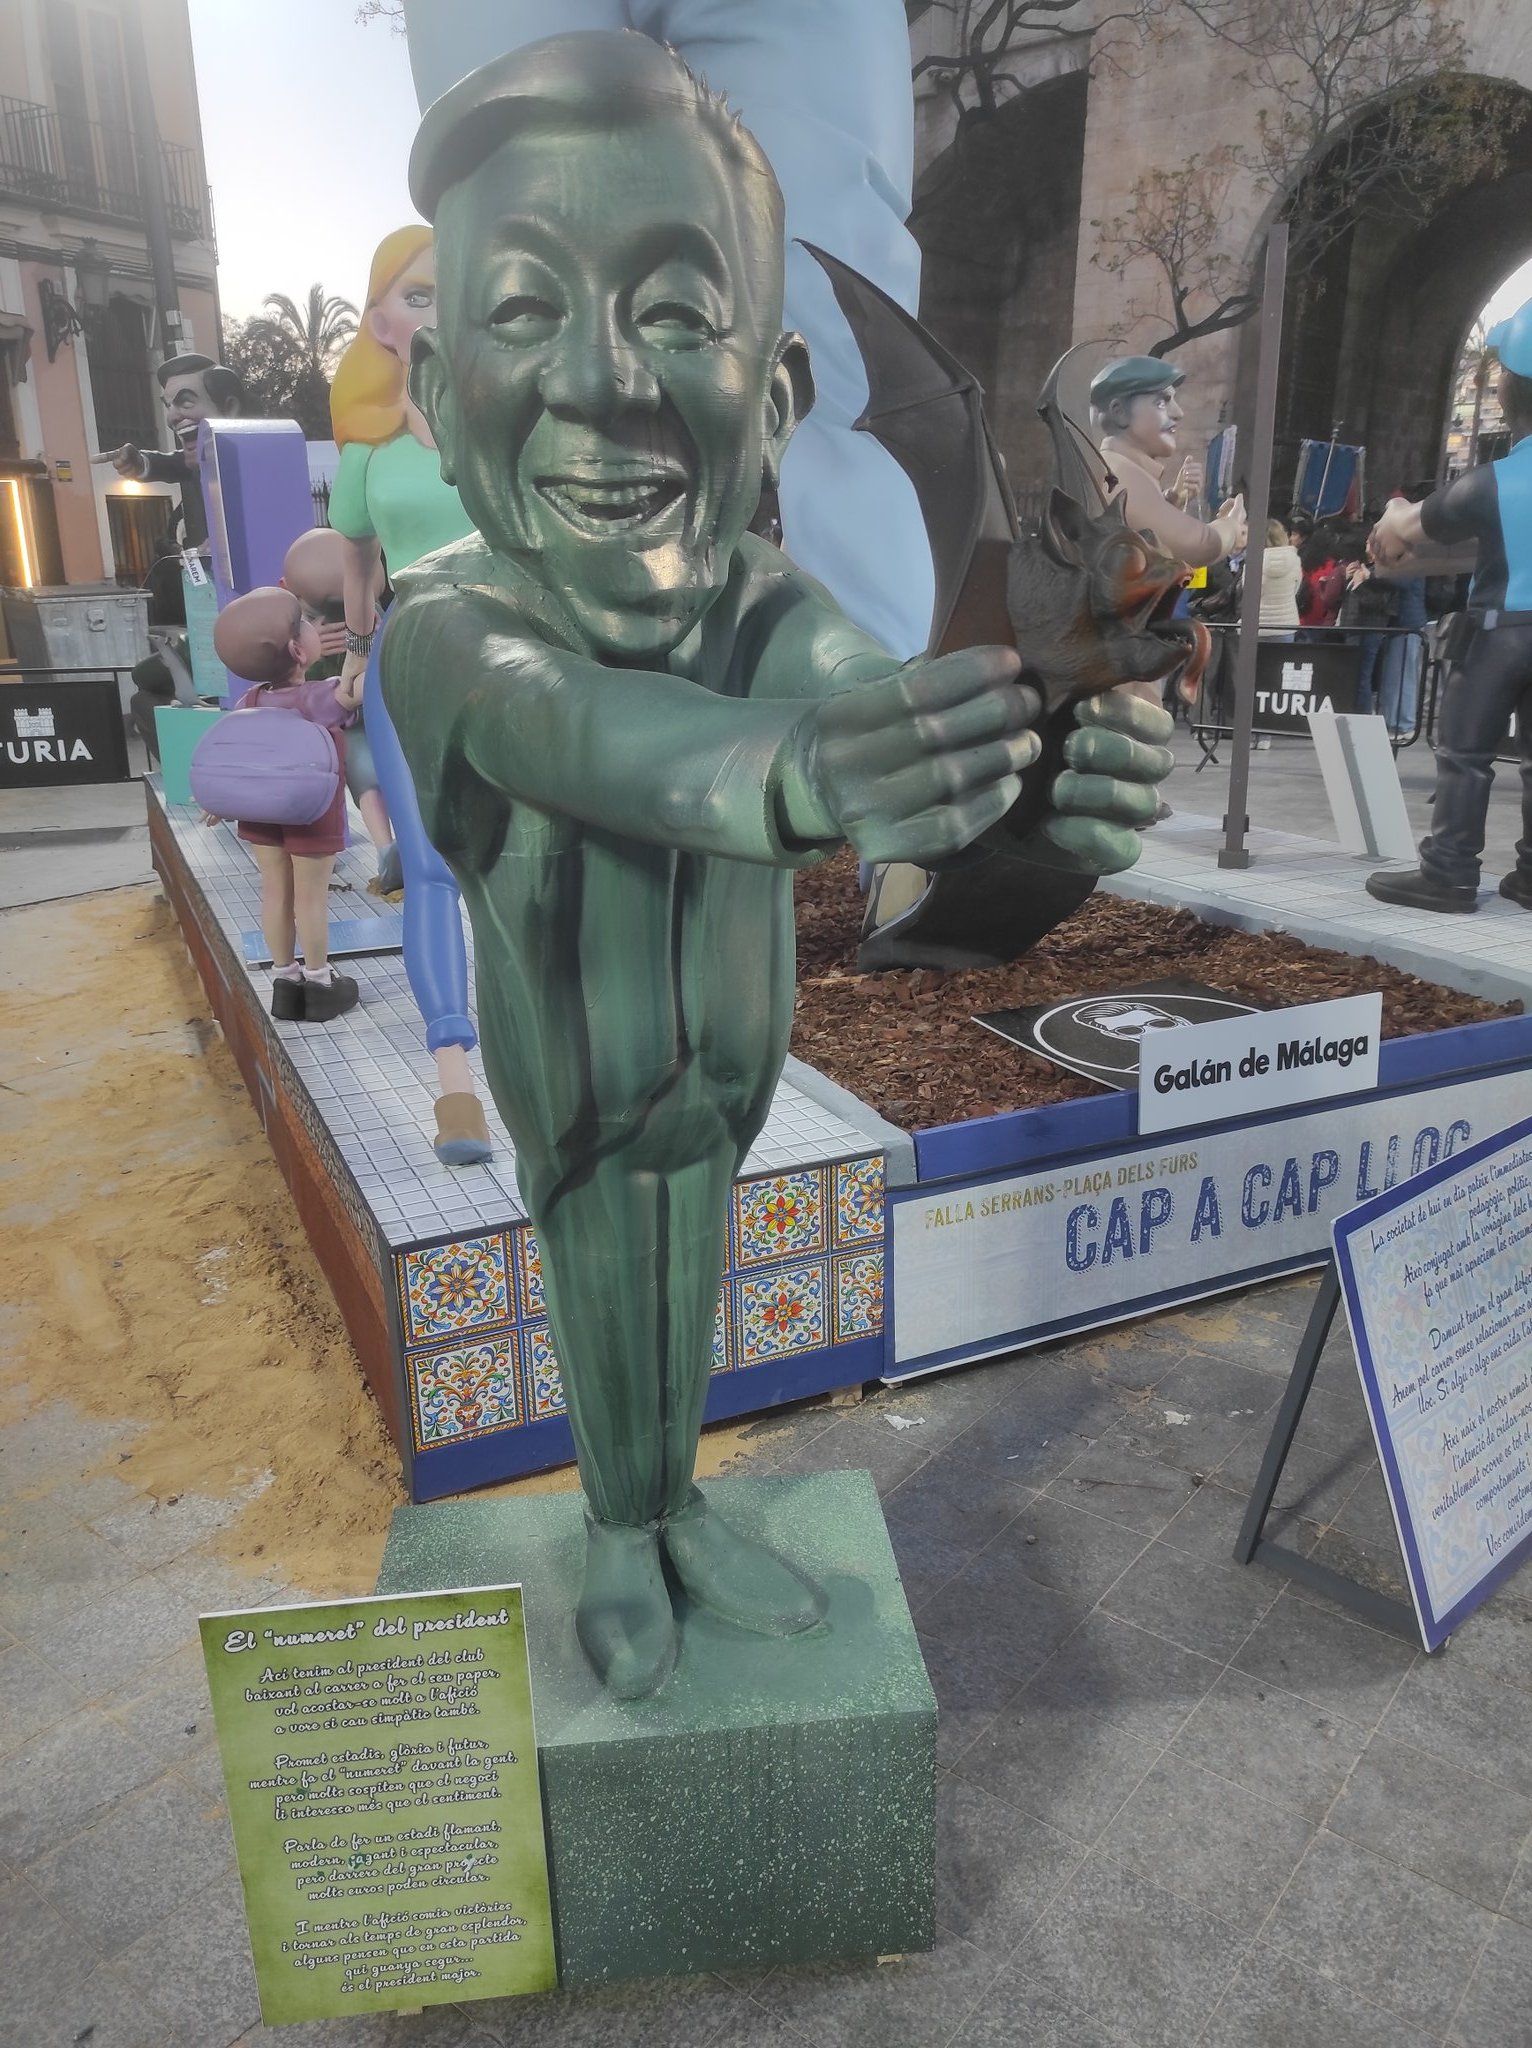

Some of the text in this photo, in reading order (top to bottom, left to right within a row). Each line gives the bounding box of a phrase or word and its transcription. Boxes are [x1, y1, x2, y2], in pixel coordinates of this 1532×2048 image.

[1256, 691, 1334, 716] TURIA
[0, 738, 94, 764] URIA
[1154, 1035, 1368, 1094] Galán de Málaga
[925, 1201, 975, 1230] FALLA
[1117, 1160, 1155, 1185] DELS
[1159, 1151, 1198, 1176] FURS
[1065, 1187, 1175, 1273] CAP
[1190, 1176, 1223, 1242] A
[1241, 1149, 1340, 1230] CAP
[1370, 1171, 1489, 1254] La societat de hui en dia pateix
[1423, 1241, 1455, 1276] conjugat
[1456, 1228, 1471, 1253] amb
[1513, 1196, 1527, 1218] dels
[1423, 1231, 1507, 1308] fa que mai apreciem les
[1428, 1286, 1513, 1351] Damunt tenim gran
[1392, 1302, 1526, 1409] Anem pel carrer sense relacionar-nos
[1418, 1393, 1436, 1415] lloc.
[1436, 1376, 1450, 1401] Si
[1474, 1352, 1490, 1376] algo
[1503, 1327, 1522, 1352] crida
[223, 1630, 257, 1654] El
[373, 1616, 407, 1637] del
[412, 1608, 510, 1641] president
[260, 1647, 485, 1684] Ací tenim al president del club
[245, 1669, 500, 1702] baixant al carrer a fer el seu paper,
[274, 1702, 480, 1735] a vore si cau simpàtic també.
[275, 1701, 297, 1717] vol
[301, 1698, 376, 1714] acostar-se
[380, 1691, 411, 1706] molt
[415, 1694, 425, 1703] a
[249, 1774, 297, 1789] mentre
[300, 1770, 317, 1789] fa
[321, 1768, 334, 1782] el
[411, 1756, 460, 1773] davant
[465, 1753, 479, 1767] la
[483, 1751, 518, 1771] gent,
[274, 1737, 489, 1770] Promet estadis, glòria i futur,
[308, 1785, 344, 1800] molts
[348, 1780, 405, 1799] sospiten
[408, 1780, 432, 1795] que
[436, 1773, 450, 1787] el
[454, 1770, 497, 1789] negoci
[275, 1786, 502, 1821] li interessa més que el sentiment.
[283, 1820, 502, 1854] Parla de fer un estadi flamant,
[290, 1854, 345, 1870] modern,
[400, 1846, 406, 1858] i
[410, 1837, 499, 1860] espectacular,
[308, 1870, 490, 1901] molts euros poden circular.
[328, 1869, 378, 1882] darrere
[382, 1861, 405, 1876] del
[408, 1862, 441, 1878] gran
[282, 1914, 527, 1953] i tornar als temps de gran esplendor,
[295, 1919, 309, 1936] I
[313, 1918, 358, 1933] mentre
[411, 1907, 450, 1921] somia
[454, 1901, 512, 1917] victòries
[293, 1929, 520, 1971] alguns pensen que en esta partida
[340, 1967, 481, 1993] és el president major.
[344, 1963, 367, 1981] qui
[371, 1960, 421, 1979] guanya
